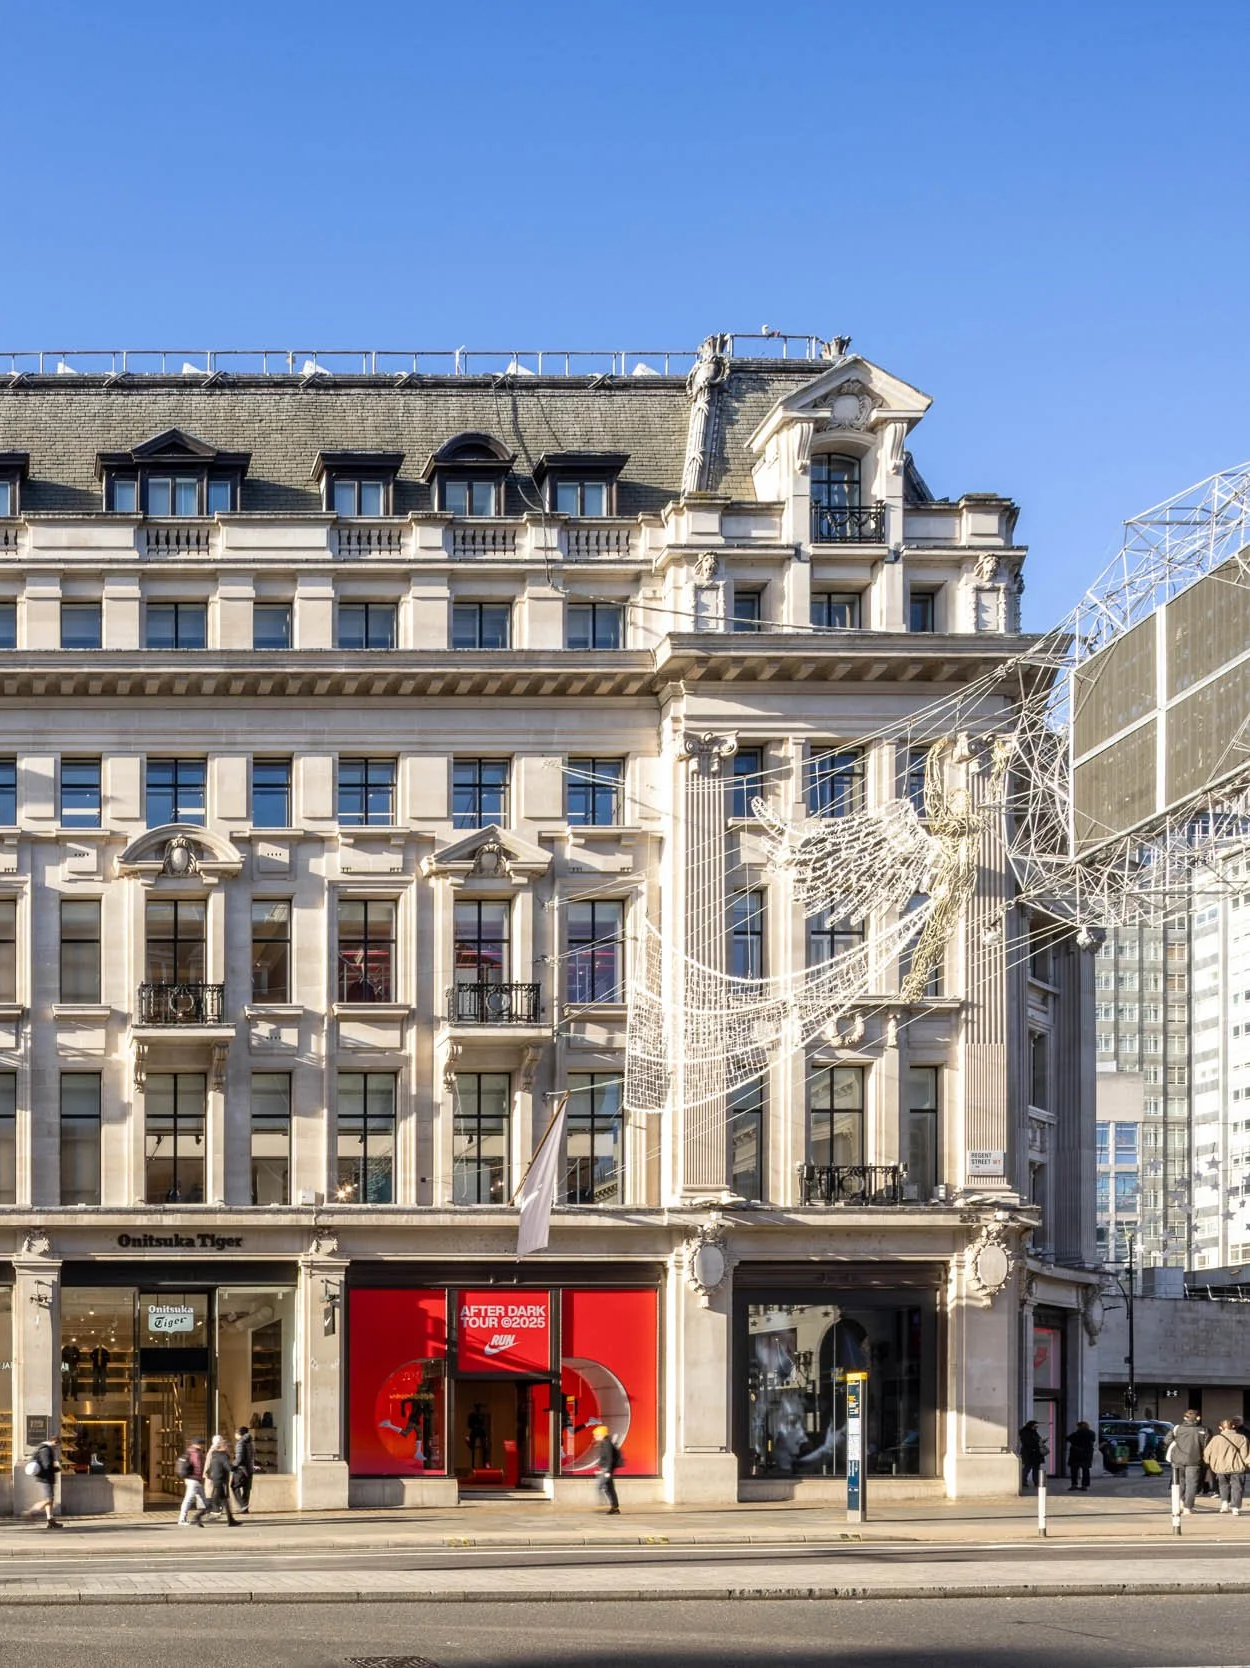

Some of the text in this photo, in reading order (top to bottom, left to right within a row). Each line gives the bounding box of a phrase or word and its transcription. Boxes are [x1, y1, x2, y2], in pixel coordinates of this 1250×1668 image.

[117, 1233, 243, 1250] Onitsuka Tiger
[148, 1304, 194, 1314] Onitsuka
[460, 1305, 546, 1317] AFTER DARK
[154, 1316, 188, 1329] Tiger
[460, 1317, 546, 1328] TOUR ©2025
[490, 1334, 516, 1346] RUN
